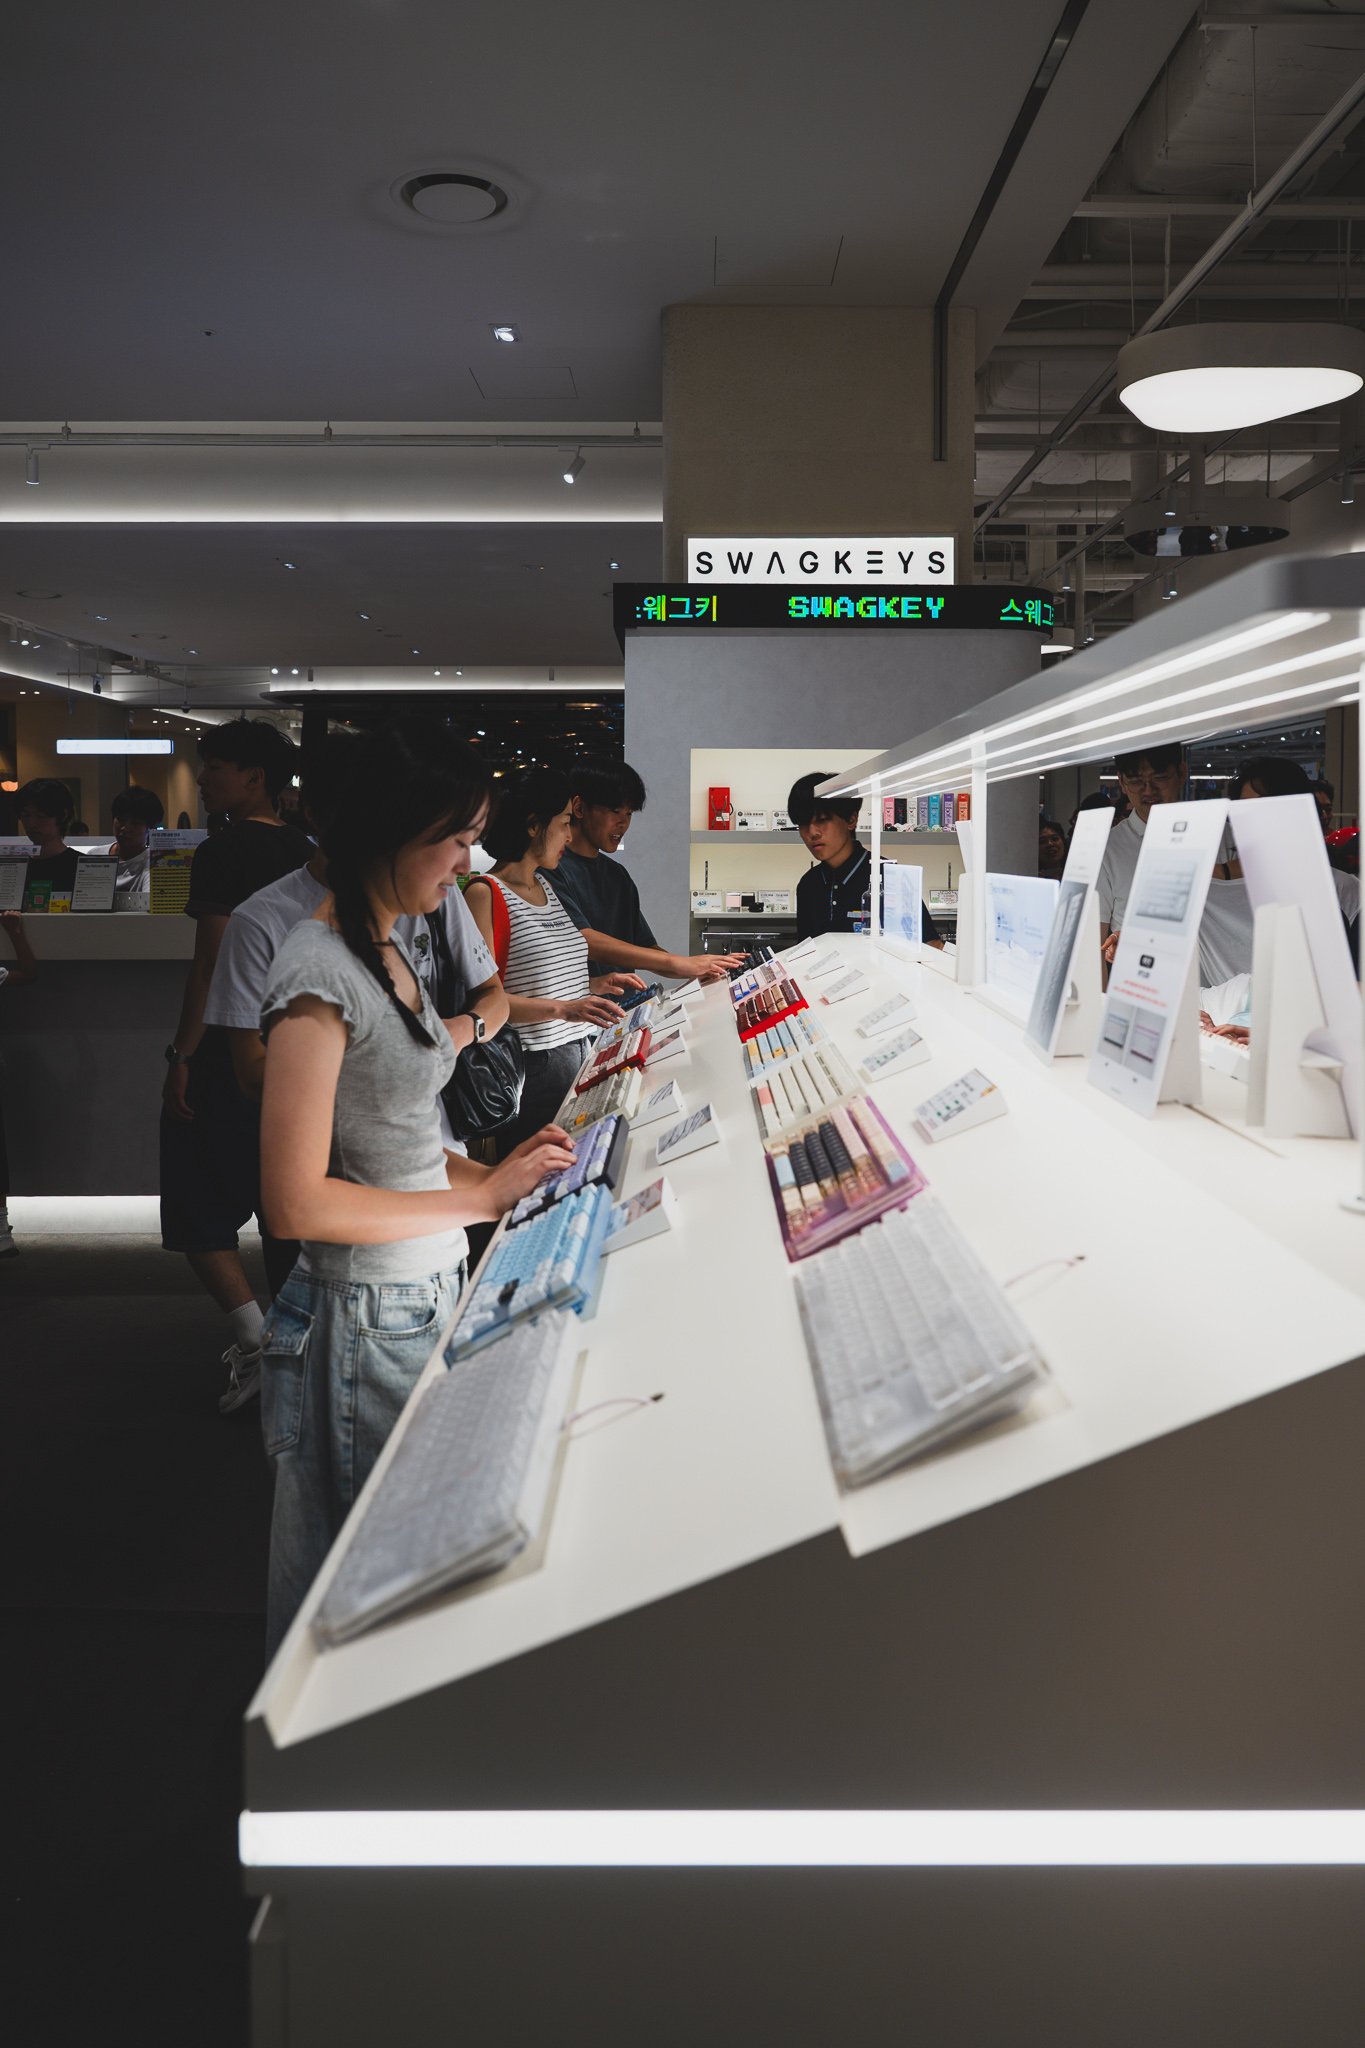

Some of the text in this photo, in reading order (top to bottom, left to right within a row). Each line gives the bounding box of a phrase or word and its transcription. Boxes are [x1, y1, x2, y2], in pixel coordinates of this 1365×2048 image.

[695, 550, 945, 575] SWAGKEYS
[635, 594, 717, 622] 웨그키
[788, 596, 945, 619] SWAGKEY
[999, 598, 1054, 626] 스웨그
